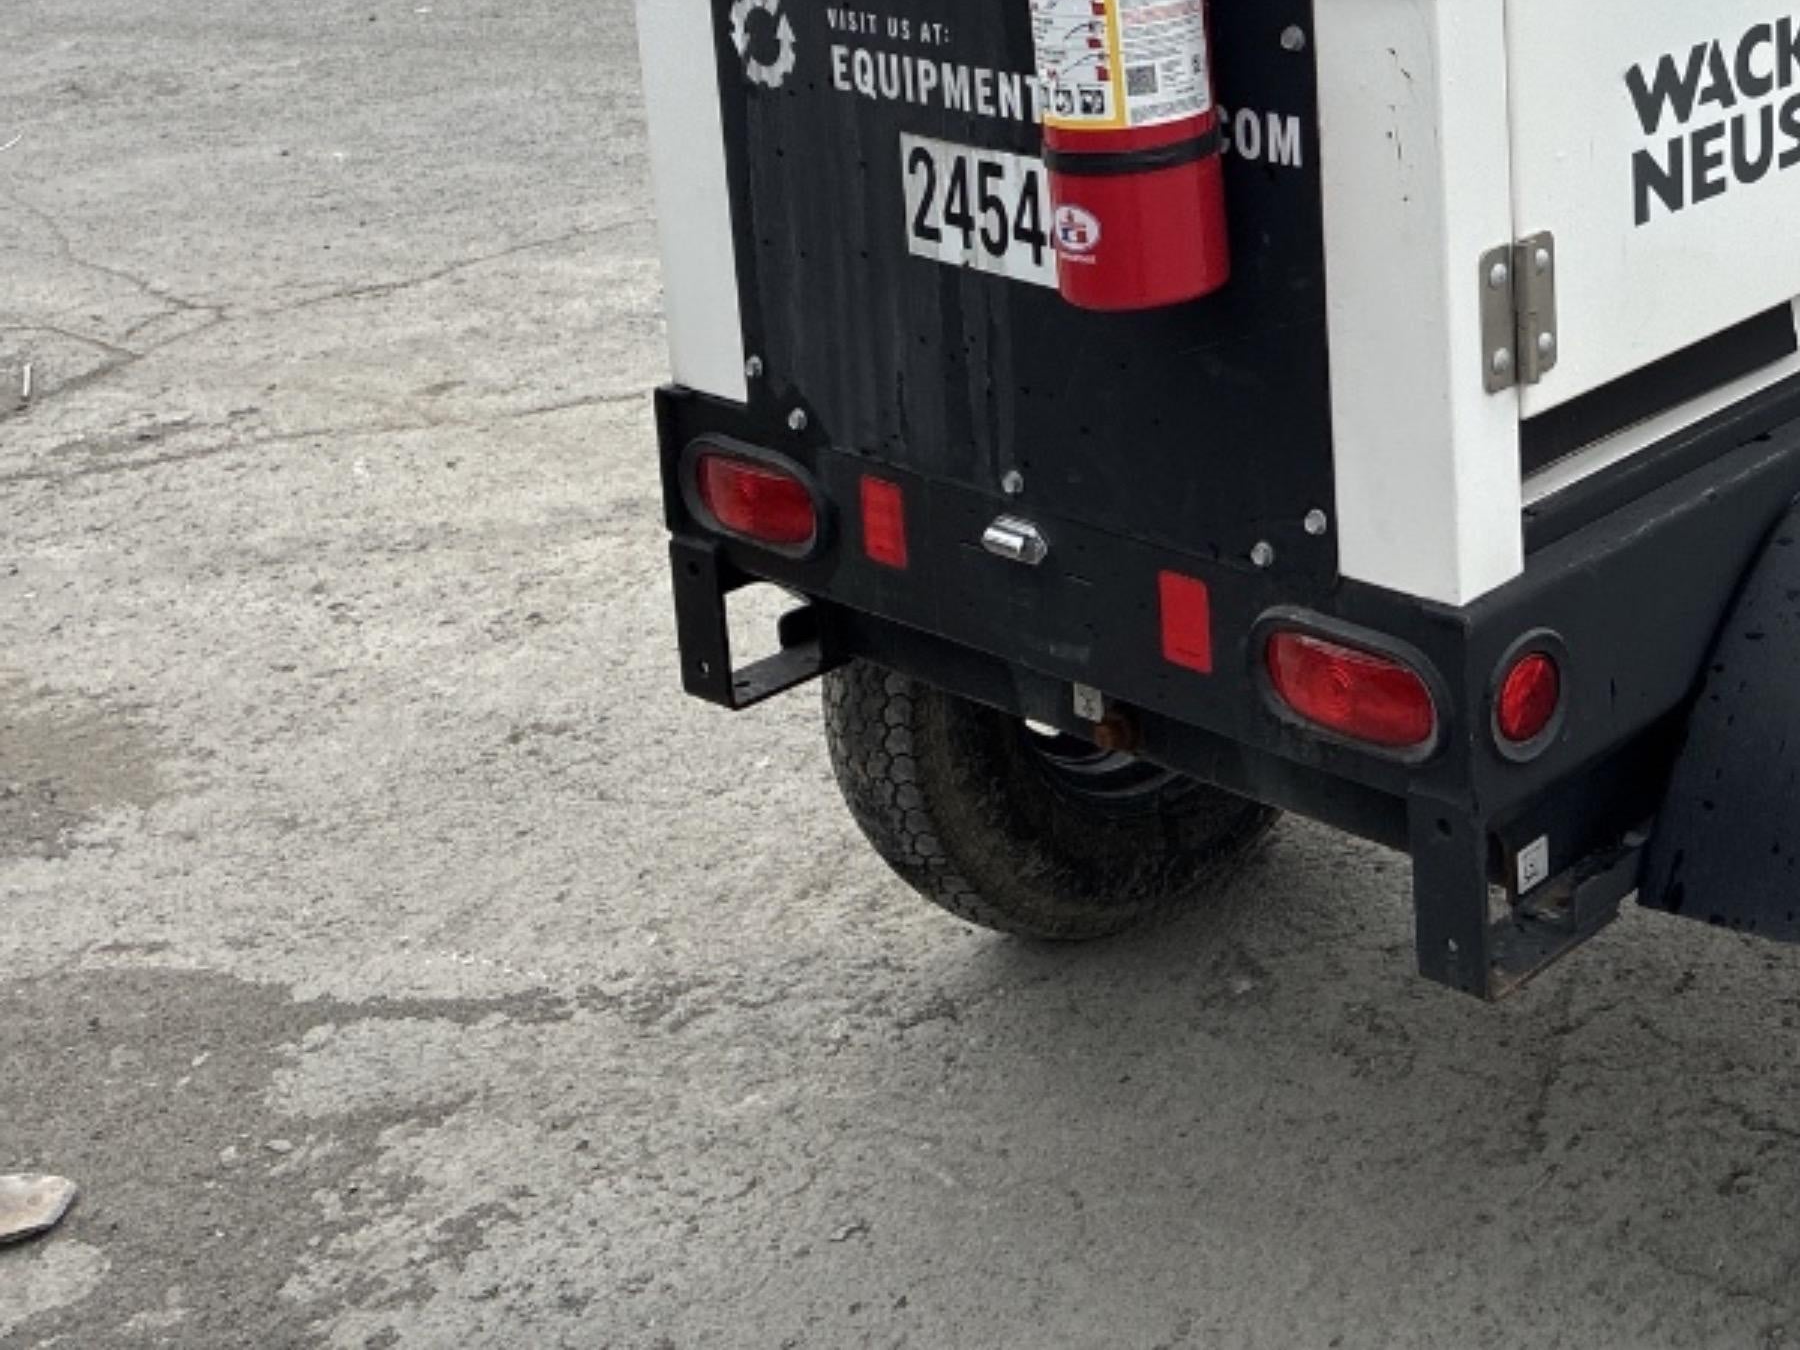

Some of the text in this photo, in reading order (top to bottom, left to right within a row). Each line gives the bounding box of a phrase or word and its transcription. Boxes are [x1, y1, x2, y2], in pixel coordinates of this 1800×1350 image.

[826, 7, 951, 46] VISIT US AT:
[907, 146, 1056, 267] 2454
